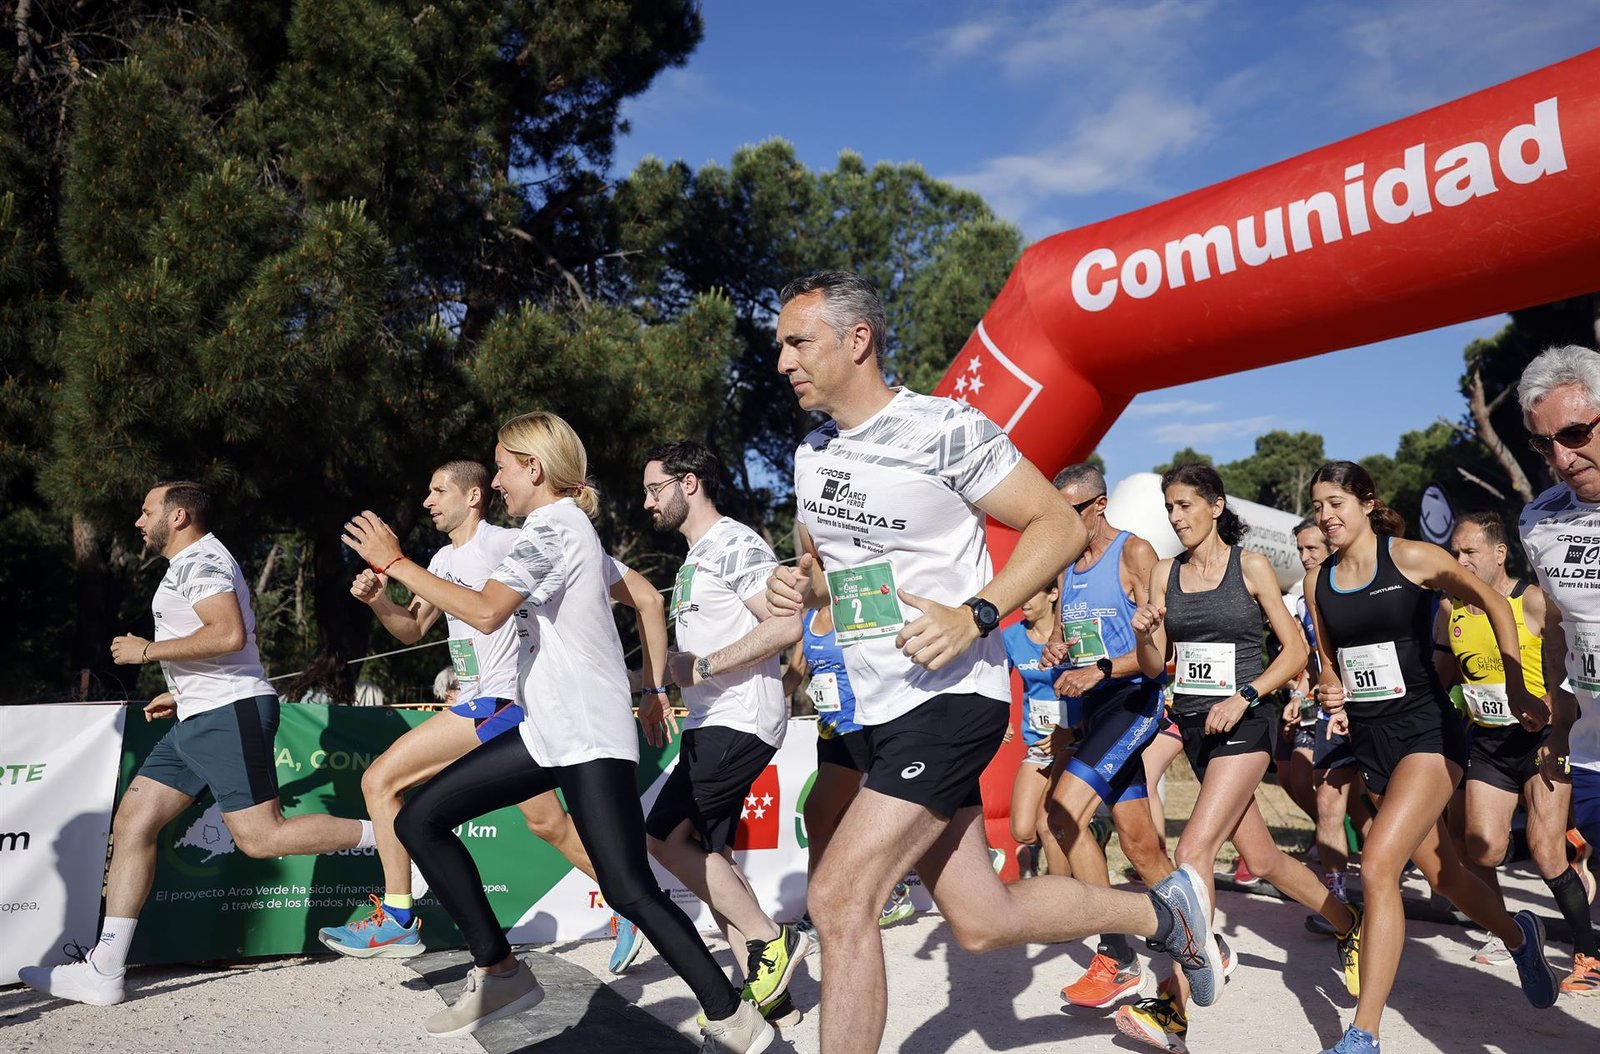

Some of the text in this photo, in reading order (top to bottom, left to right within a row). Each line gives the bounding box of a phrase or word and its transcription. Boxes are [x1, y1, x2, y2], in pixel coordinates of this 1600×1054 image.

[1071, 96, 1568, 312] Comunidad
[820, 467, 852, 480] CROSS
[848, 491, 867, 502] ARCO
[846, 499, 865, 509] VERDE
[803, 498, 907, 530] VALDELATAS
[1369, 584, 1402, 596] PORTUGAL
[852, 598, 864, 624] 2
[1063, 602, 1087, 612] CLUB
[1189, 662, 1211, 679] 512
[1581, 653, 1597, 677] 14
[1354, 669, 1378, 688] 511
[814, 690, 824, 703] 24
[1482, 701, 1504, 714] 637
[1039, 714, 1050, 725] 16
[467, 822, 497, 838] km
[156, 891, 168, 901] El
[171, 888, 225, 903] proyecto
[228, 887, 253, 898] Arco
[256, 885, 289, 896] Verde
[292, 885, 306, 895] ha
[309, 884, 333, 895] sido
[221, 903, 228, 911] a
[231, 898, 264, 911] través
[266, 899, 282, 909] de
[285, 898, 301, 909] los
[304, 897, 343, 908] fondos
